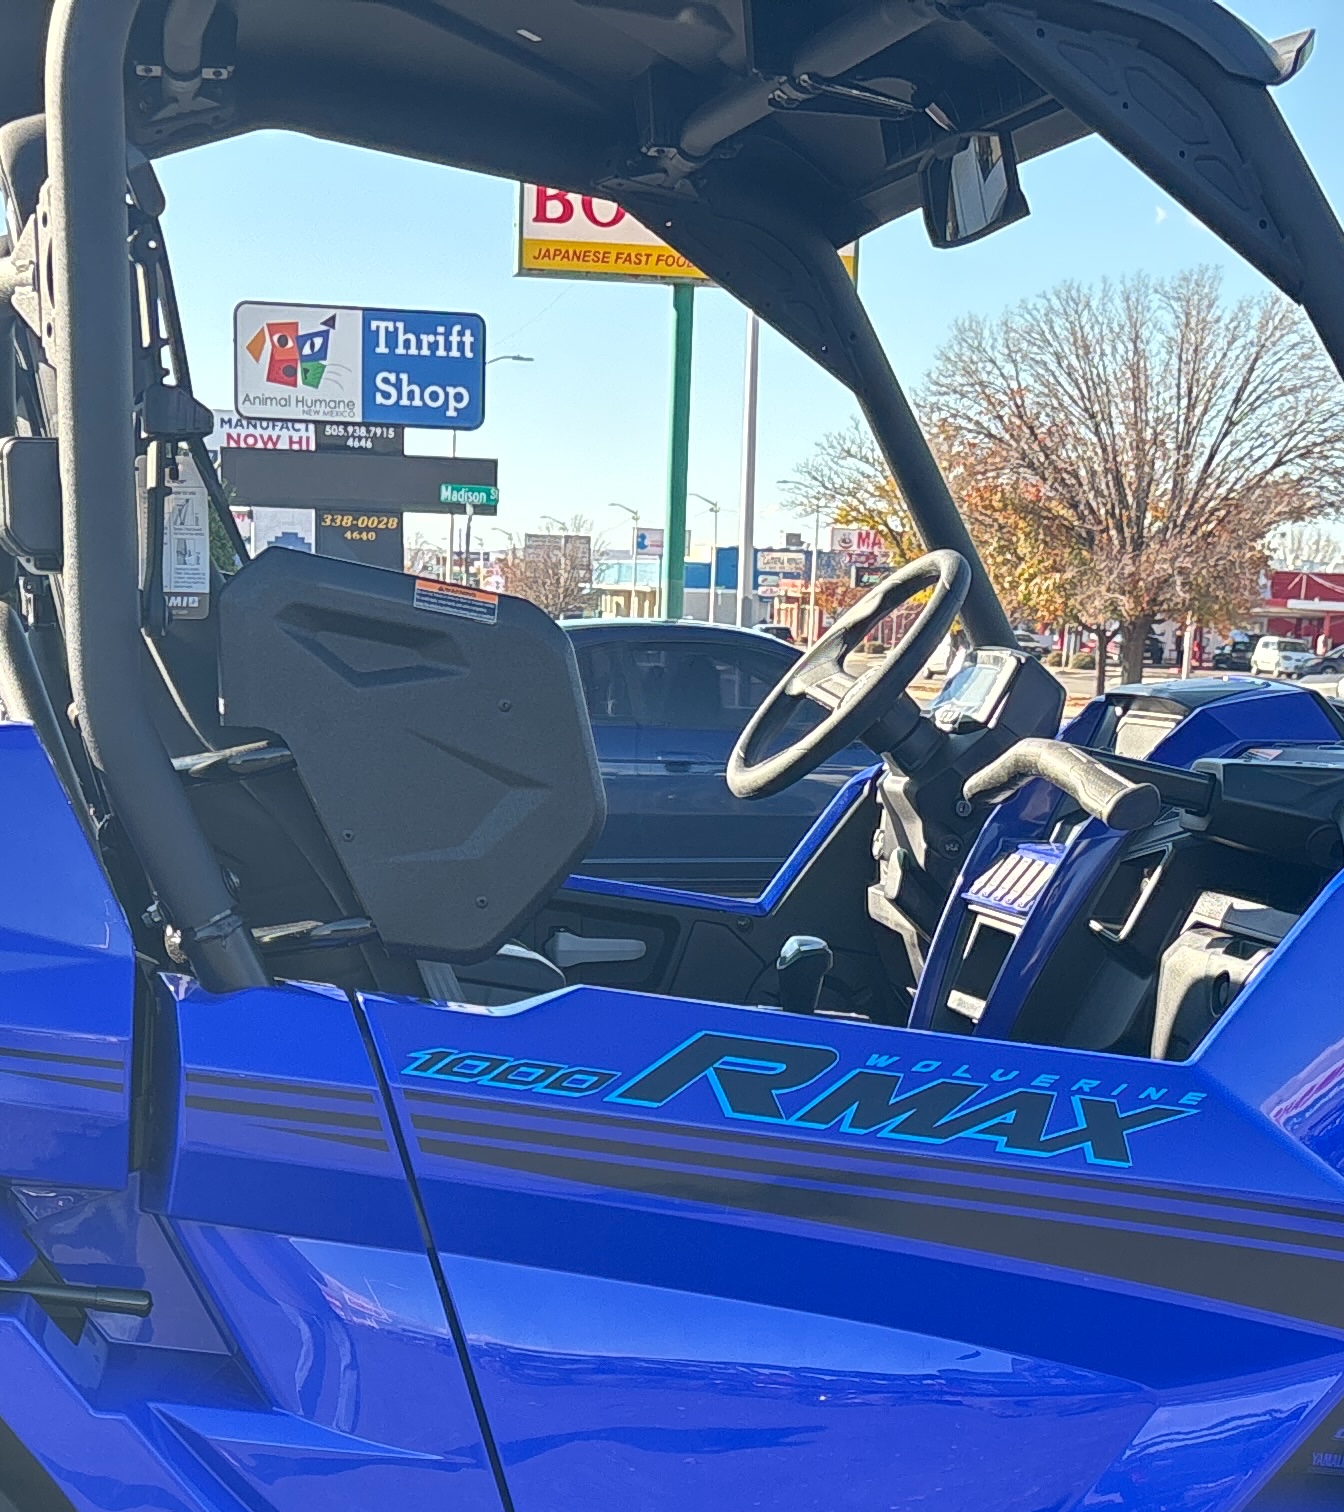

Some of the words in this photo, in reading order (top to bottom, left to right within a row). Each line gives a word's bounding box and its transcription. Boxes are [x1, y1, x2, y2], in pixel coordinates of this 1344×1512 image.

[532, 247, 611, 265] JAPANESE
[614, 251, 653, 267] FAST
[370, 320, 475, 359] Thrift
[241, 392, 292, 409] Animal
[295, 394, 356, 411] Humane
[375, 371, 470, 417] Shop
[301, 409, 321, 417] NEW
[322, 409, 356, 418] MEXICO
[324, 424, 395, 439] 505.938.7915
[226, 432, 282, 449] NOW
[288, 434, 310, 451] HI
[346, 436, 373, 449] 4646
[441, 484, 487, 504] Madison
[321, 513, 399, 529] 338-0028
[343, 531, 376, 541] 4640
[400, 1047, 623, 1097] 1000
[865, 1052, 1210, 1107] WOLVERINE
